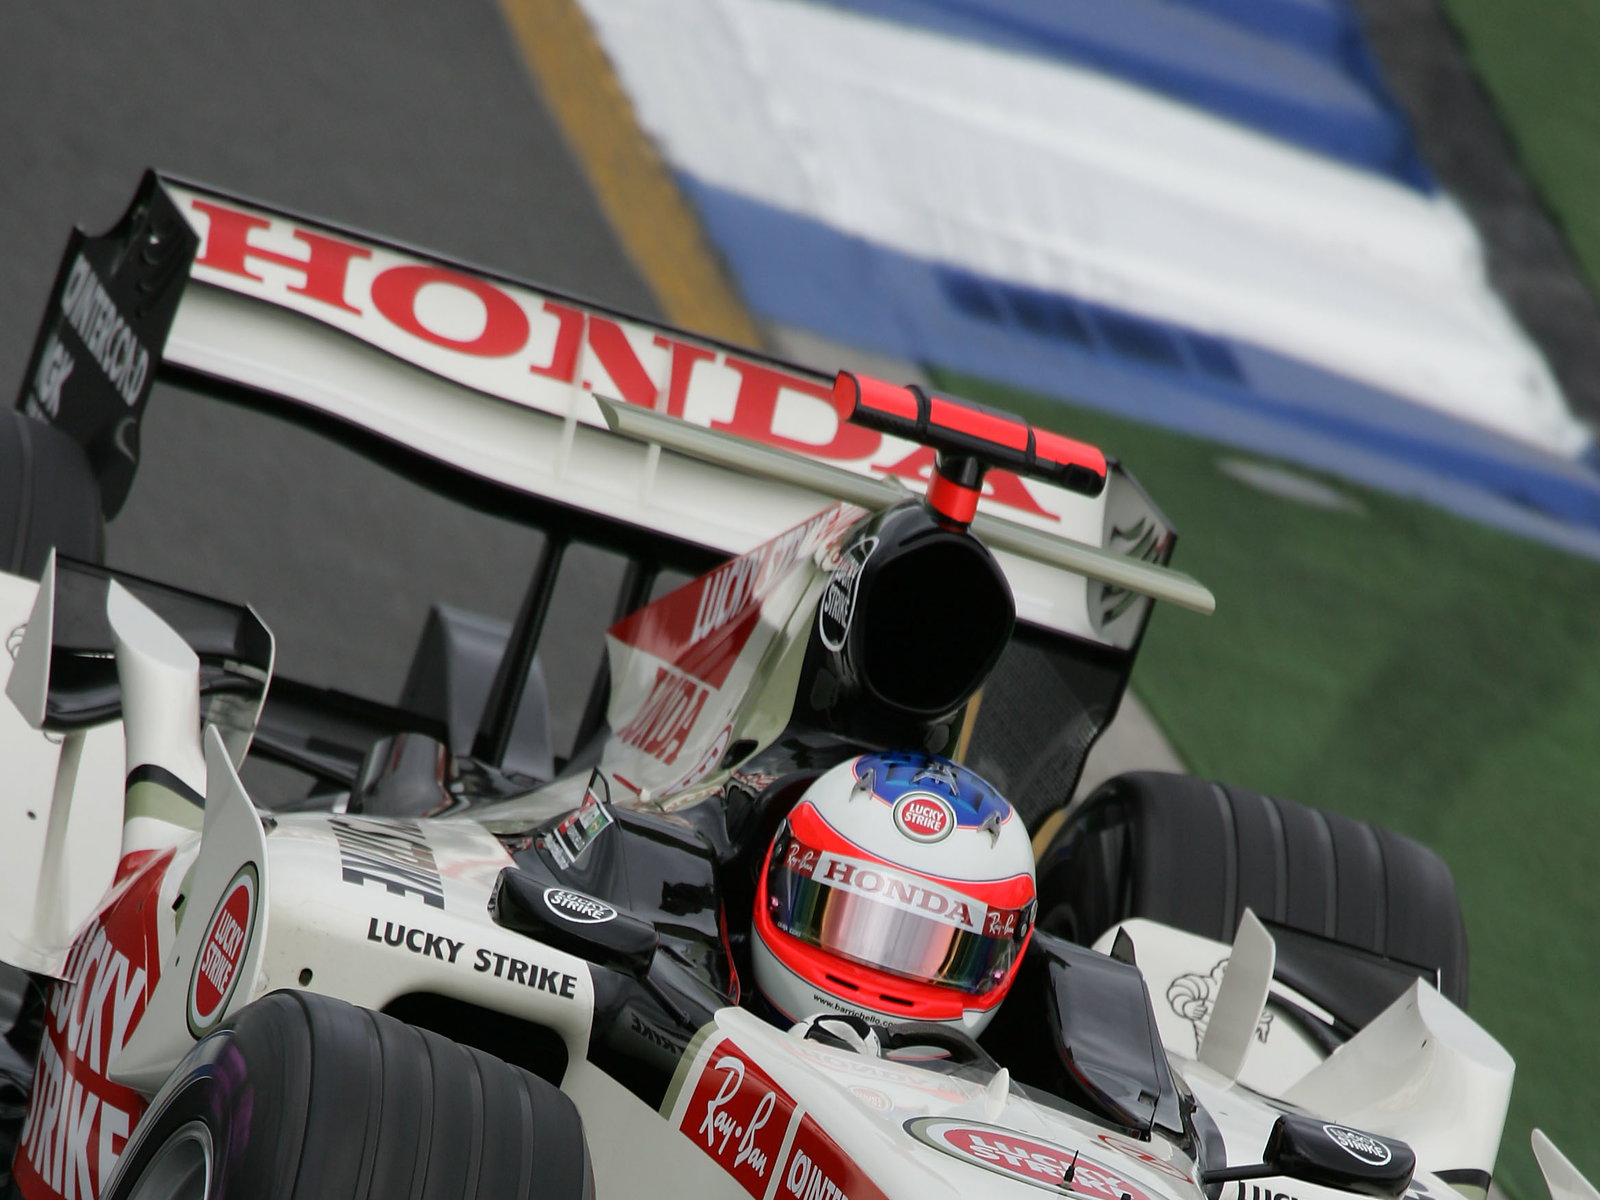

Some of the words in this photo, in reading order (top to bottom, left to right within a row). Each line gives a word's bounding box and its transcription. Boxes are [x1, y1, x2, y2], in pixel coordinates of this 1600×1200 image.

[904, 811, 942, 831] STRIKE
[908, 802, 944, 821] LUCKY
[551, 895, 604, 919] STRIKE
[558, 891, 611, 912] LUCKY
[823, 858, 975, 928] HONDA
[213, 909, 244, 958] LUCKY
[201, 943, 234, 996] STRIKE
[367, 917, 464, 964] LUCKY
[473, 948, 578, 1000] STRIKE
[813, 993, 896, 1028] www.barrichello.co
[968, 1134, 1123, 1187] LUCKY
[1337, 1136, 1386, 1158] STRIKE
